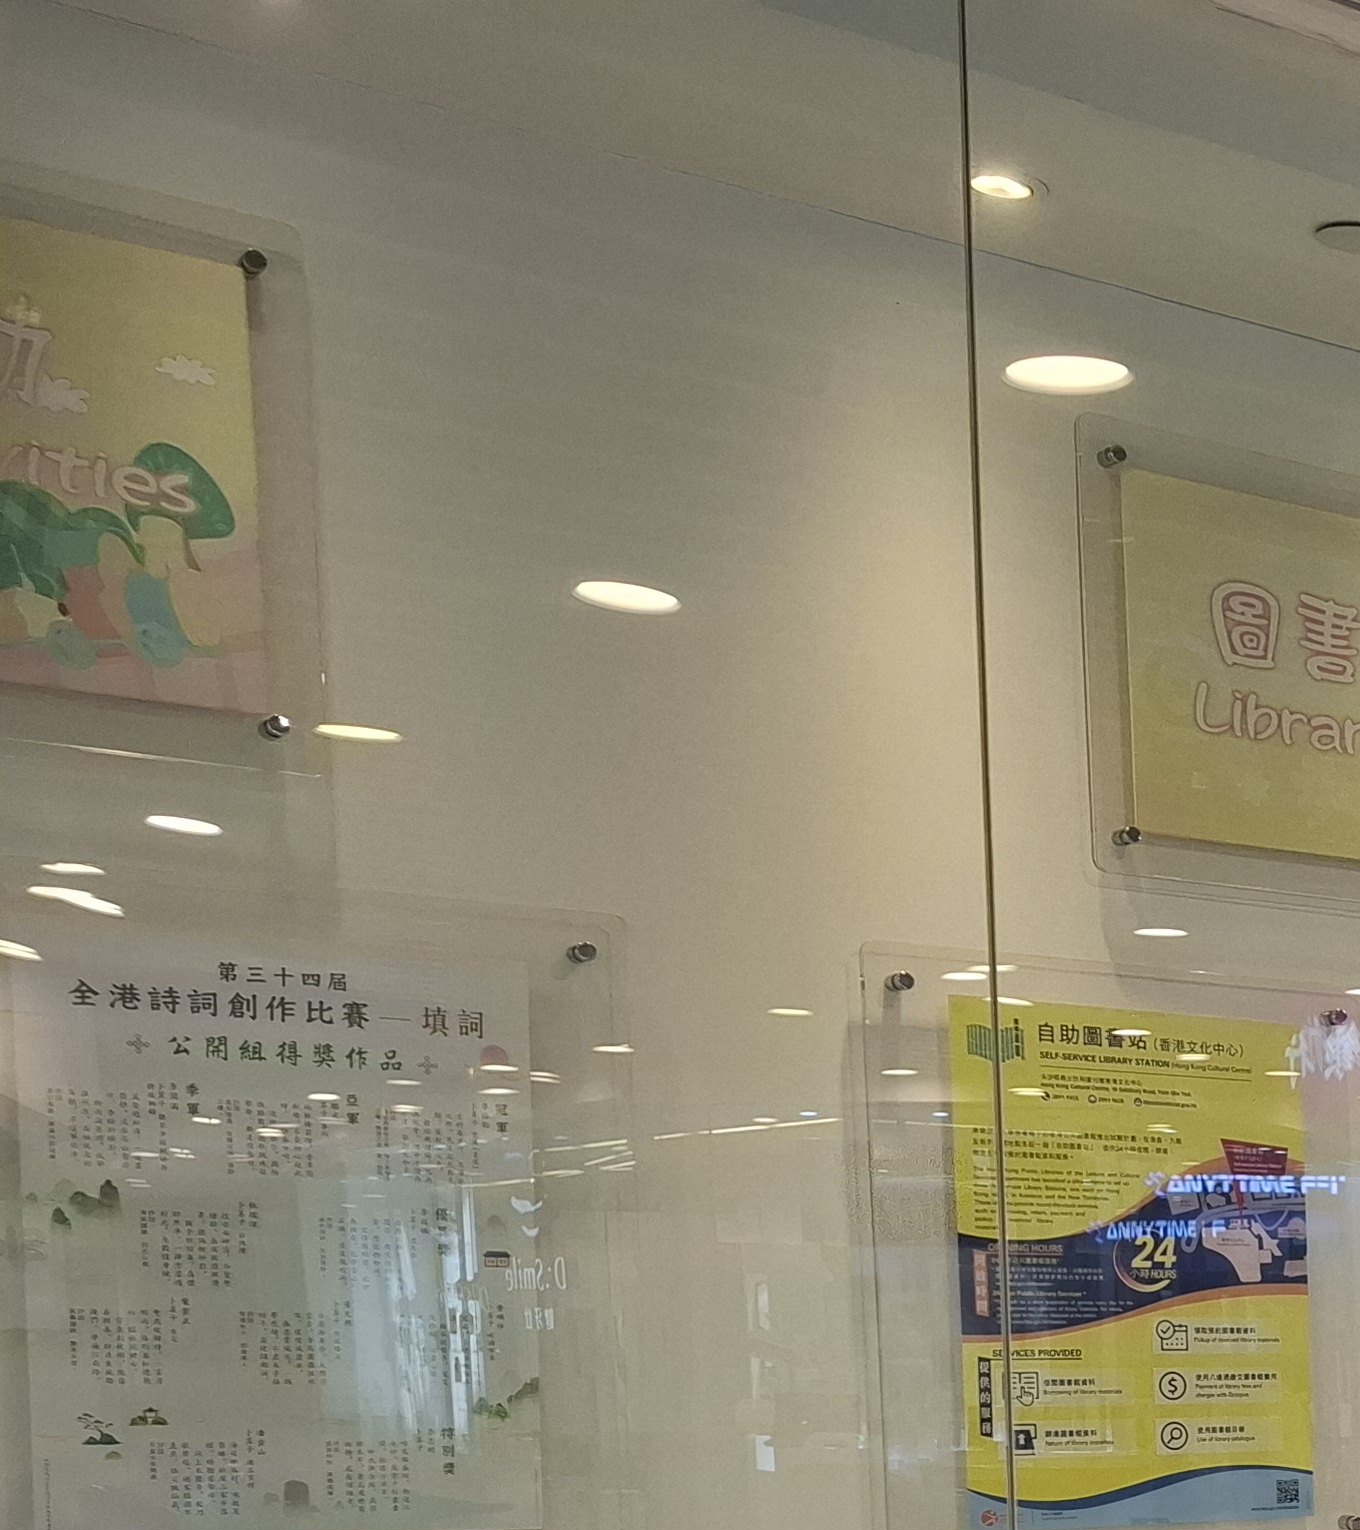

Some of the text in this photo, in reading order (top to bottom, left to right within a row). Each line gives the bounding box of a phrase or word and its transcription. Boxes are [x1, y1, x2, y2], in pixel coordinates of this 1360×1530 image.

[216, 960, 349, 993] 第三十四屆
[1037, 1022, 1148, 1051] 自助圖書站
[166, 1033, 405, 1073] 公開組得獎作品
[1039, 1050, 1098, 1064] SELF-SERVICE
[1099, 1055, 1134, 1067] LIBRARY
[1135, 1057, 1171, 1069] STATION
[345, 1093, 361, 1127] 亞軍
[1030, 1243, 1064, 1253] HOURS
[1130, 1236, 1178, 1269] 24
[1130, 1269, 1150, 1280] 小時
[1150, 1269, 1178, 1280] HOURS
[1037, 1349, 1083, 1358] PROVIDED
[439, 1426, 457, 1477] 特別獎
